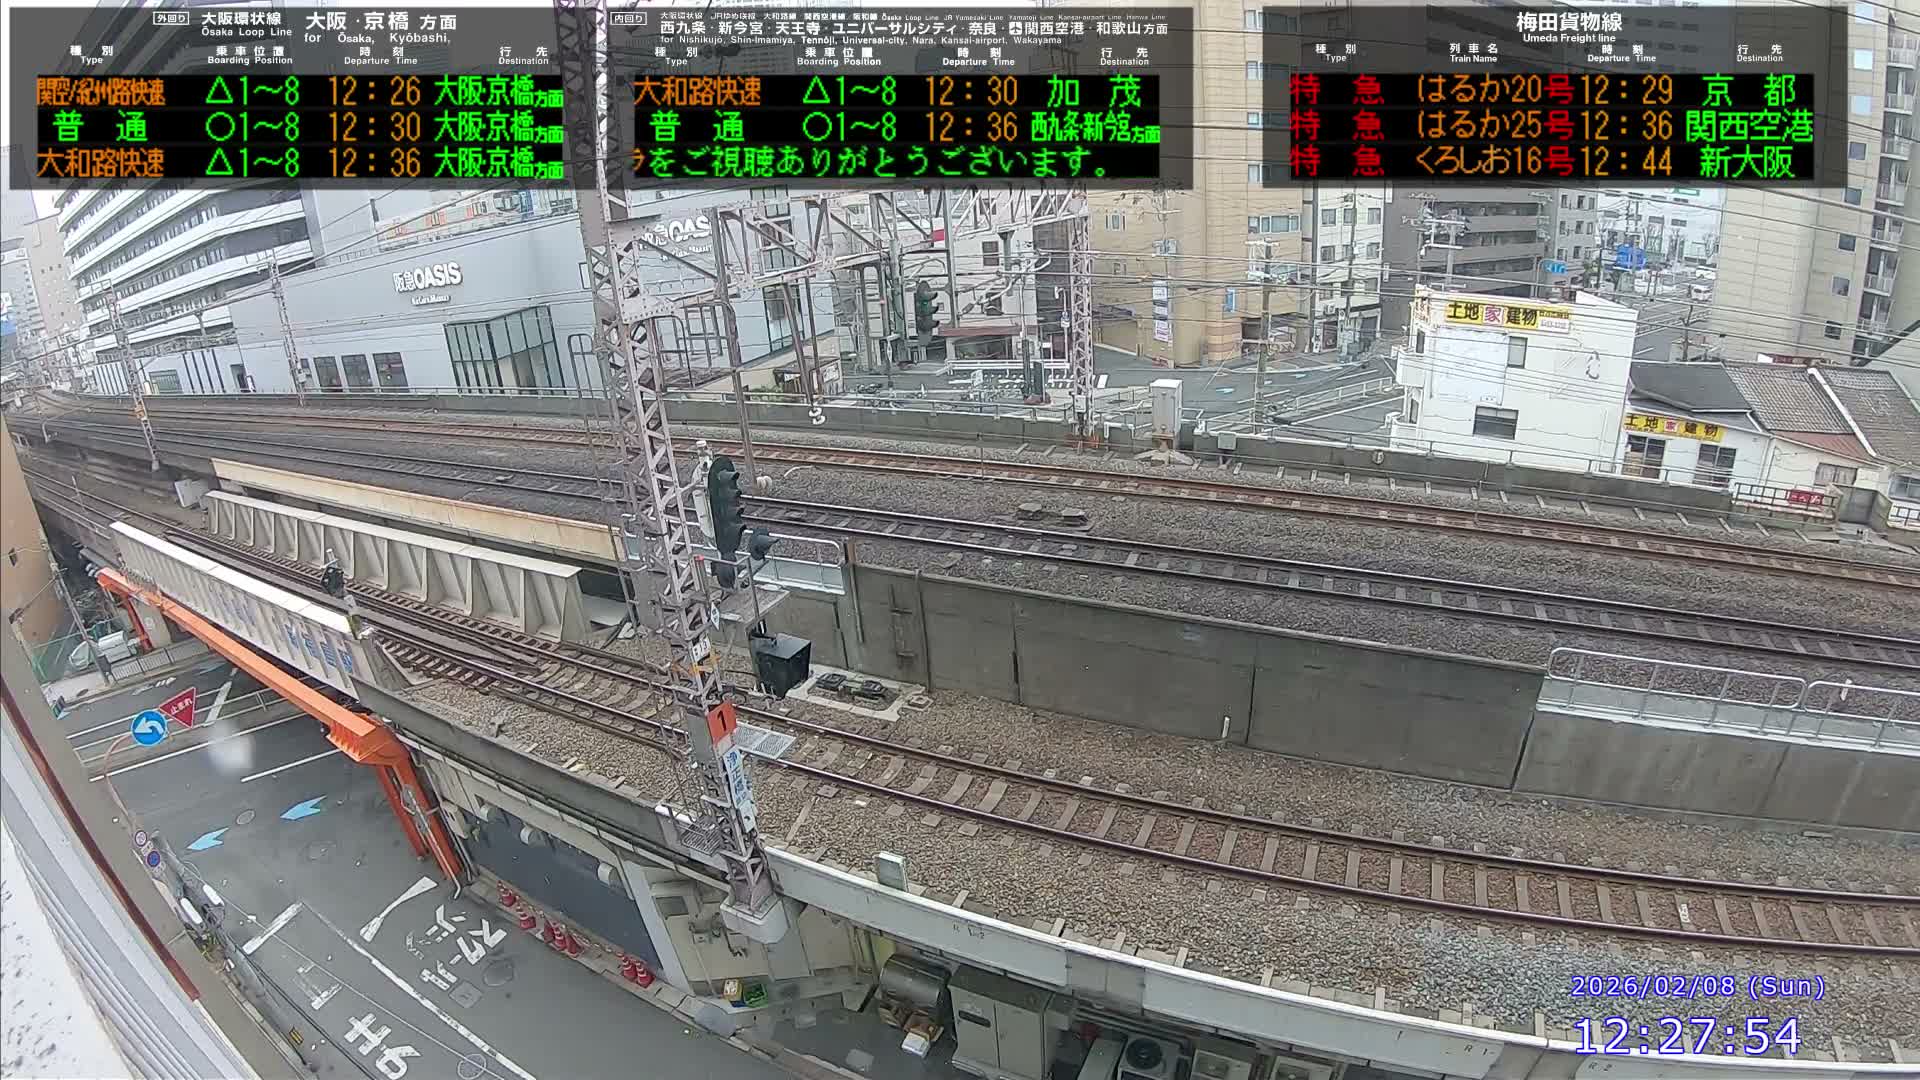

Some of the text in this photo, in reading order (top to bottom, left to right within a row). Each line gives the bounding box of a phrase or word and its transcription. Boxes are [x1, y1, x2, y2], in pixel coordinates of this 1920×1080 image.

[1448, 302, 1538, 326] 土地家建物
[170, 697, 193, 716] 止まれ
[718, 710, 727, 732] 1
